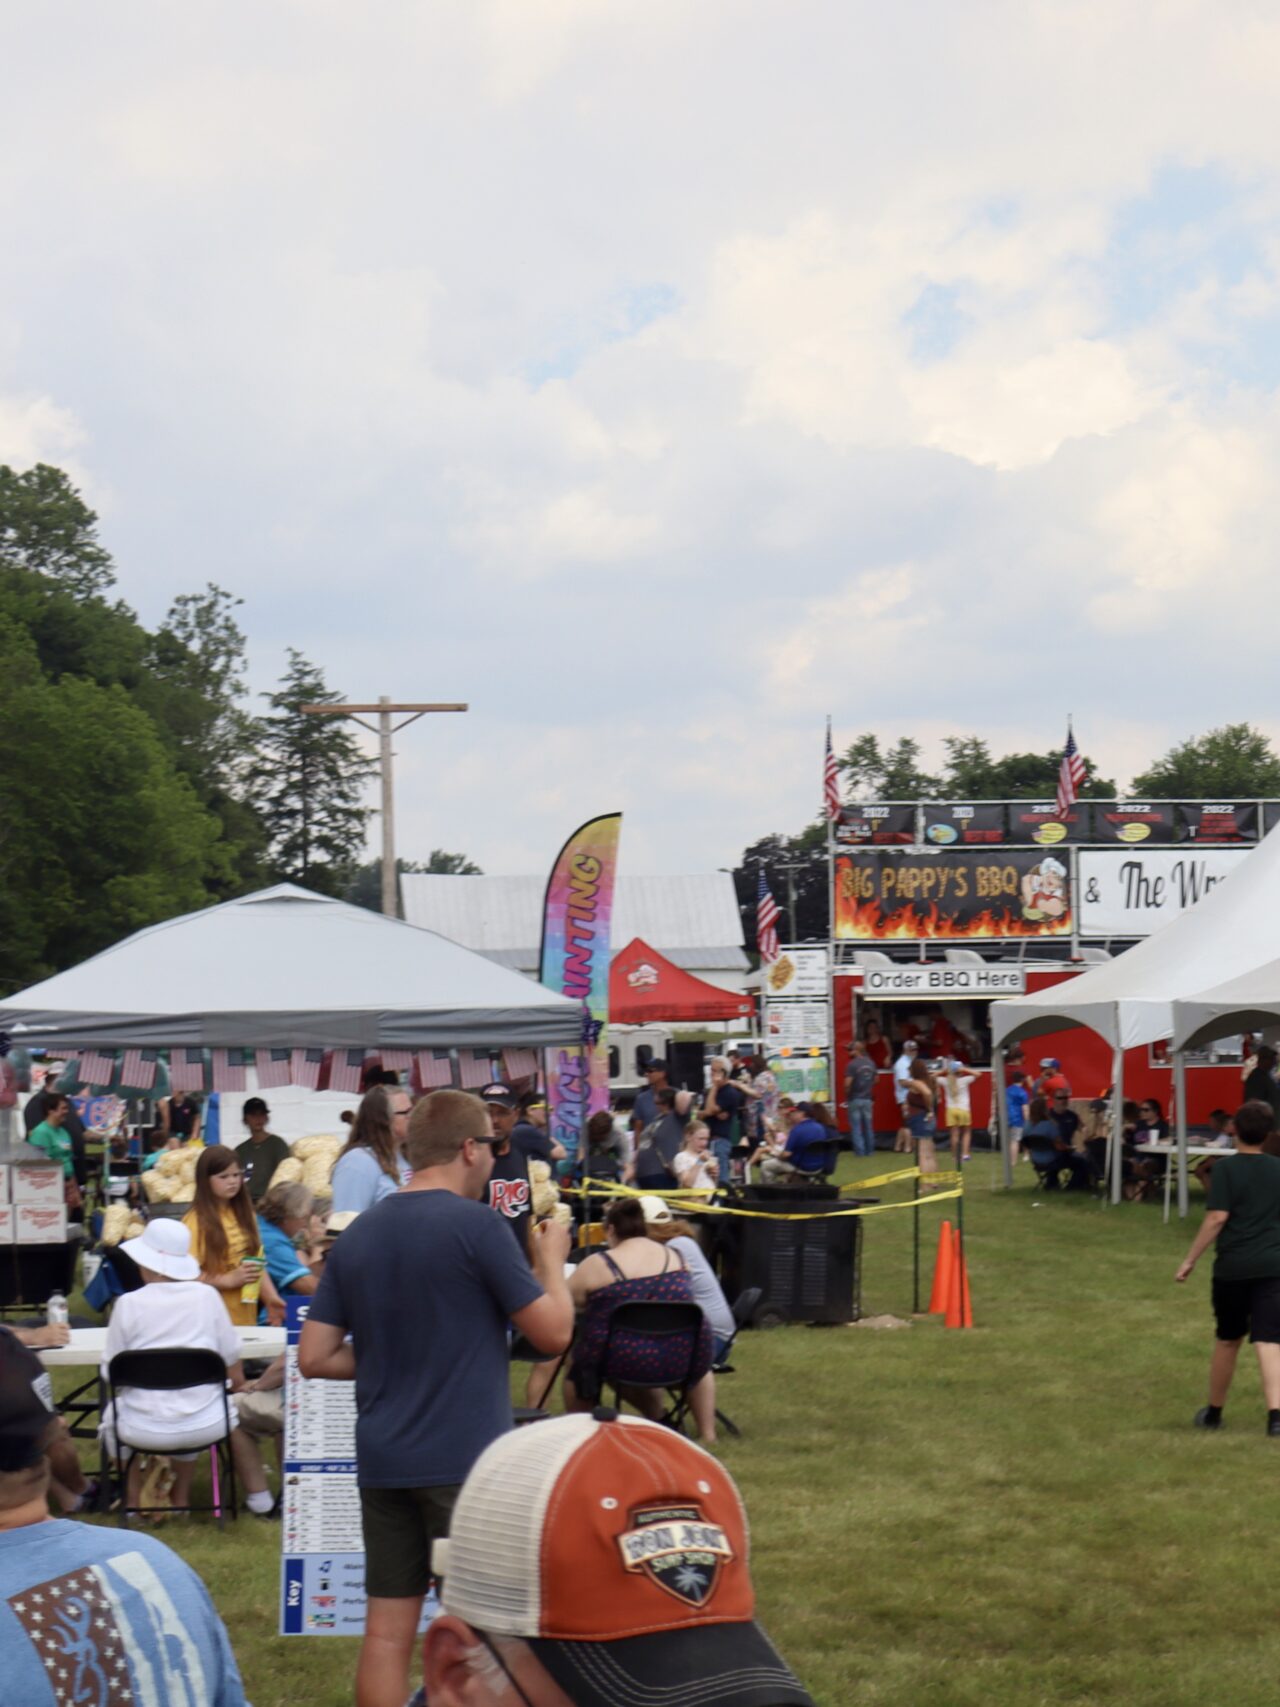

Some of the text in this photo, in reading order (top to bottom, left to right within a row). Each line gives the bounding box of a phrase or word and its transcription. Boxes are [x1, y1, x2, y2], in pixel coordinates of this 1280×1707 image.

[841, 865, 1018, 898] BIG PAPPY'S BBQ
[1085, 860, 1227, 909] & The Wr
[870, 971, 1020, 988] Order BBQ Here
[625, 1524, 724, 1560] RON JON
[287, 1580, 303, 1607] Key
